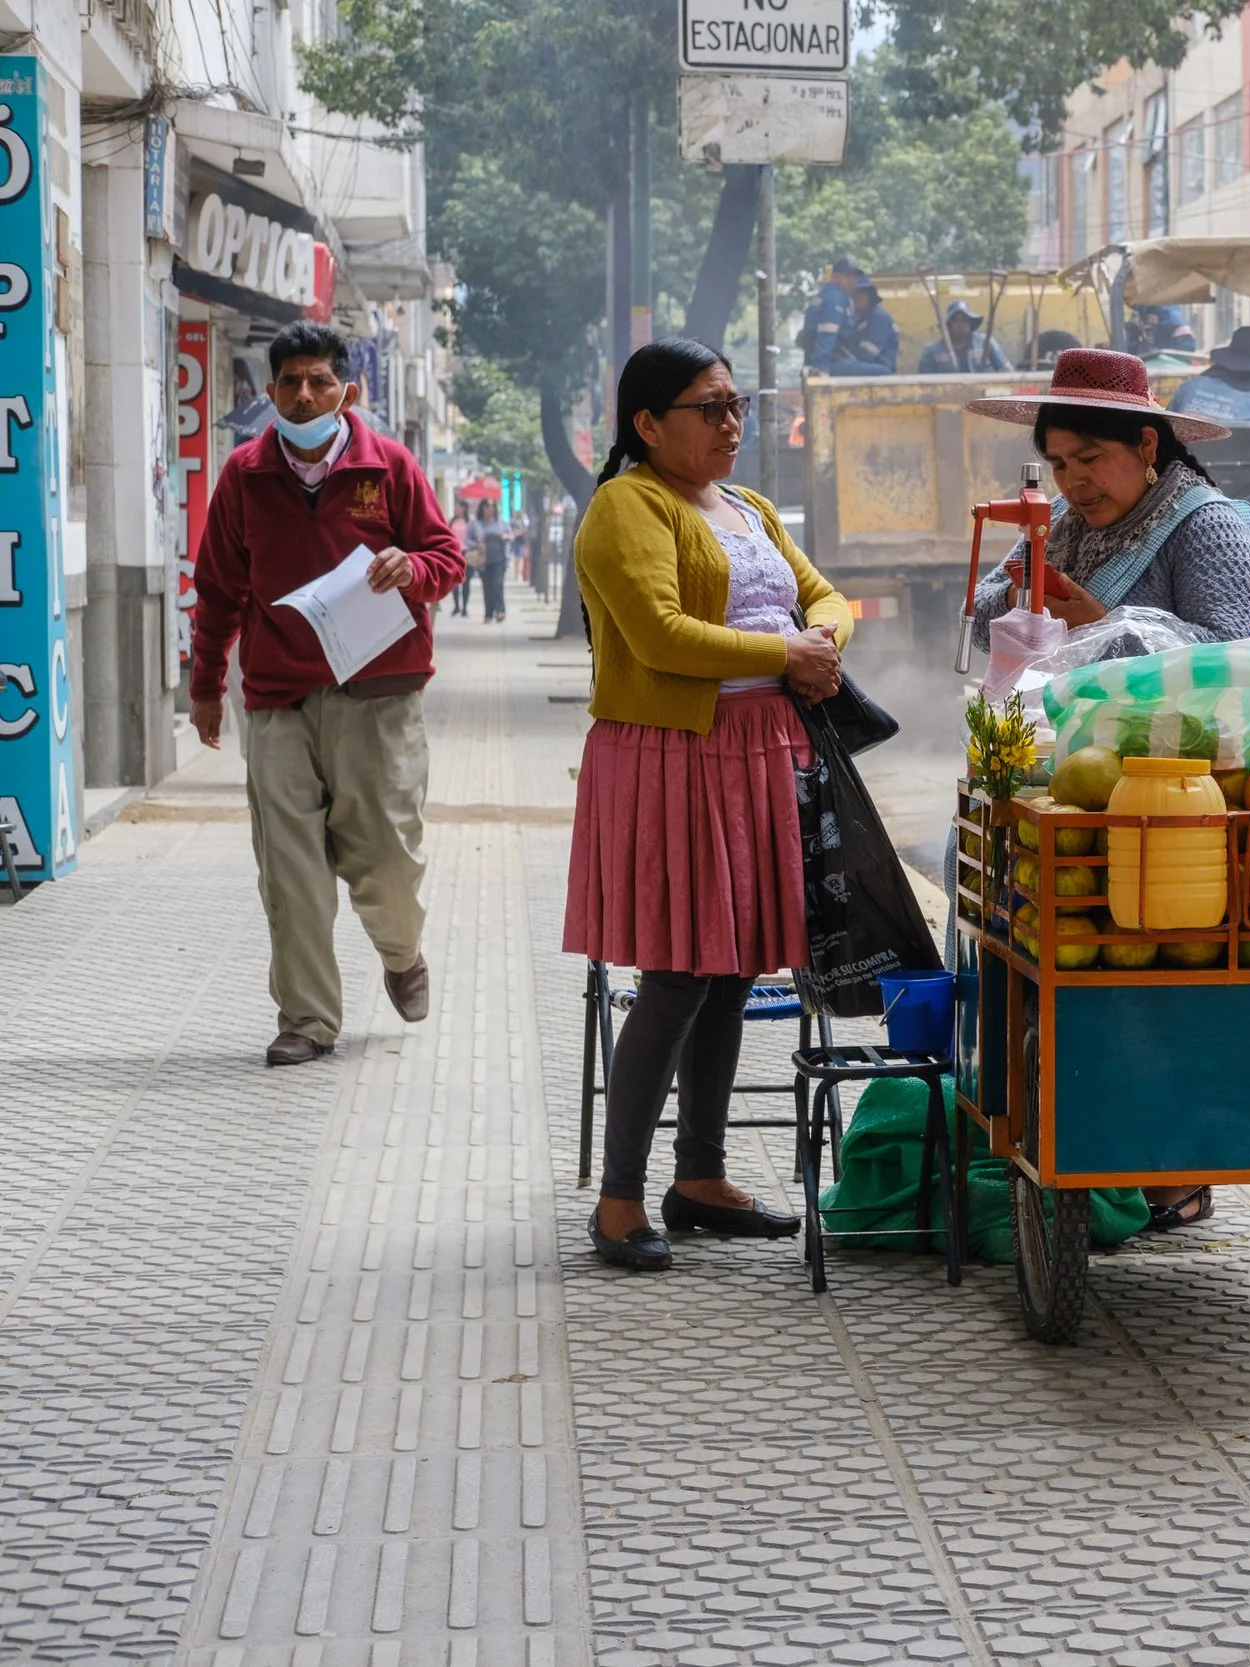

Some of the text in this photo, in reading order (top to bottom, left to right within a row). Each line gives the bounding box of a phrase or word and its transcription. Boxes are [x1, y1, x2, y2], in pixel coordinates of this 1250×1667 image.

[691, 20, 840, 55] ESTACIONAR
[196, 192, 315, 307] OPTICA
[852, 948, 898, 973] COMPRA
